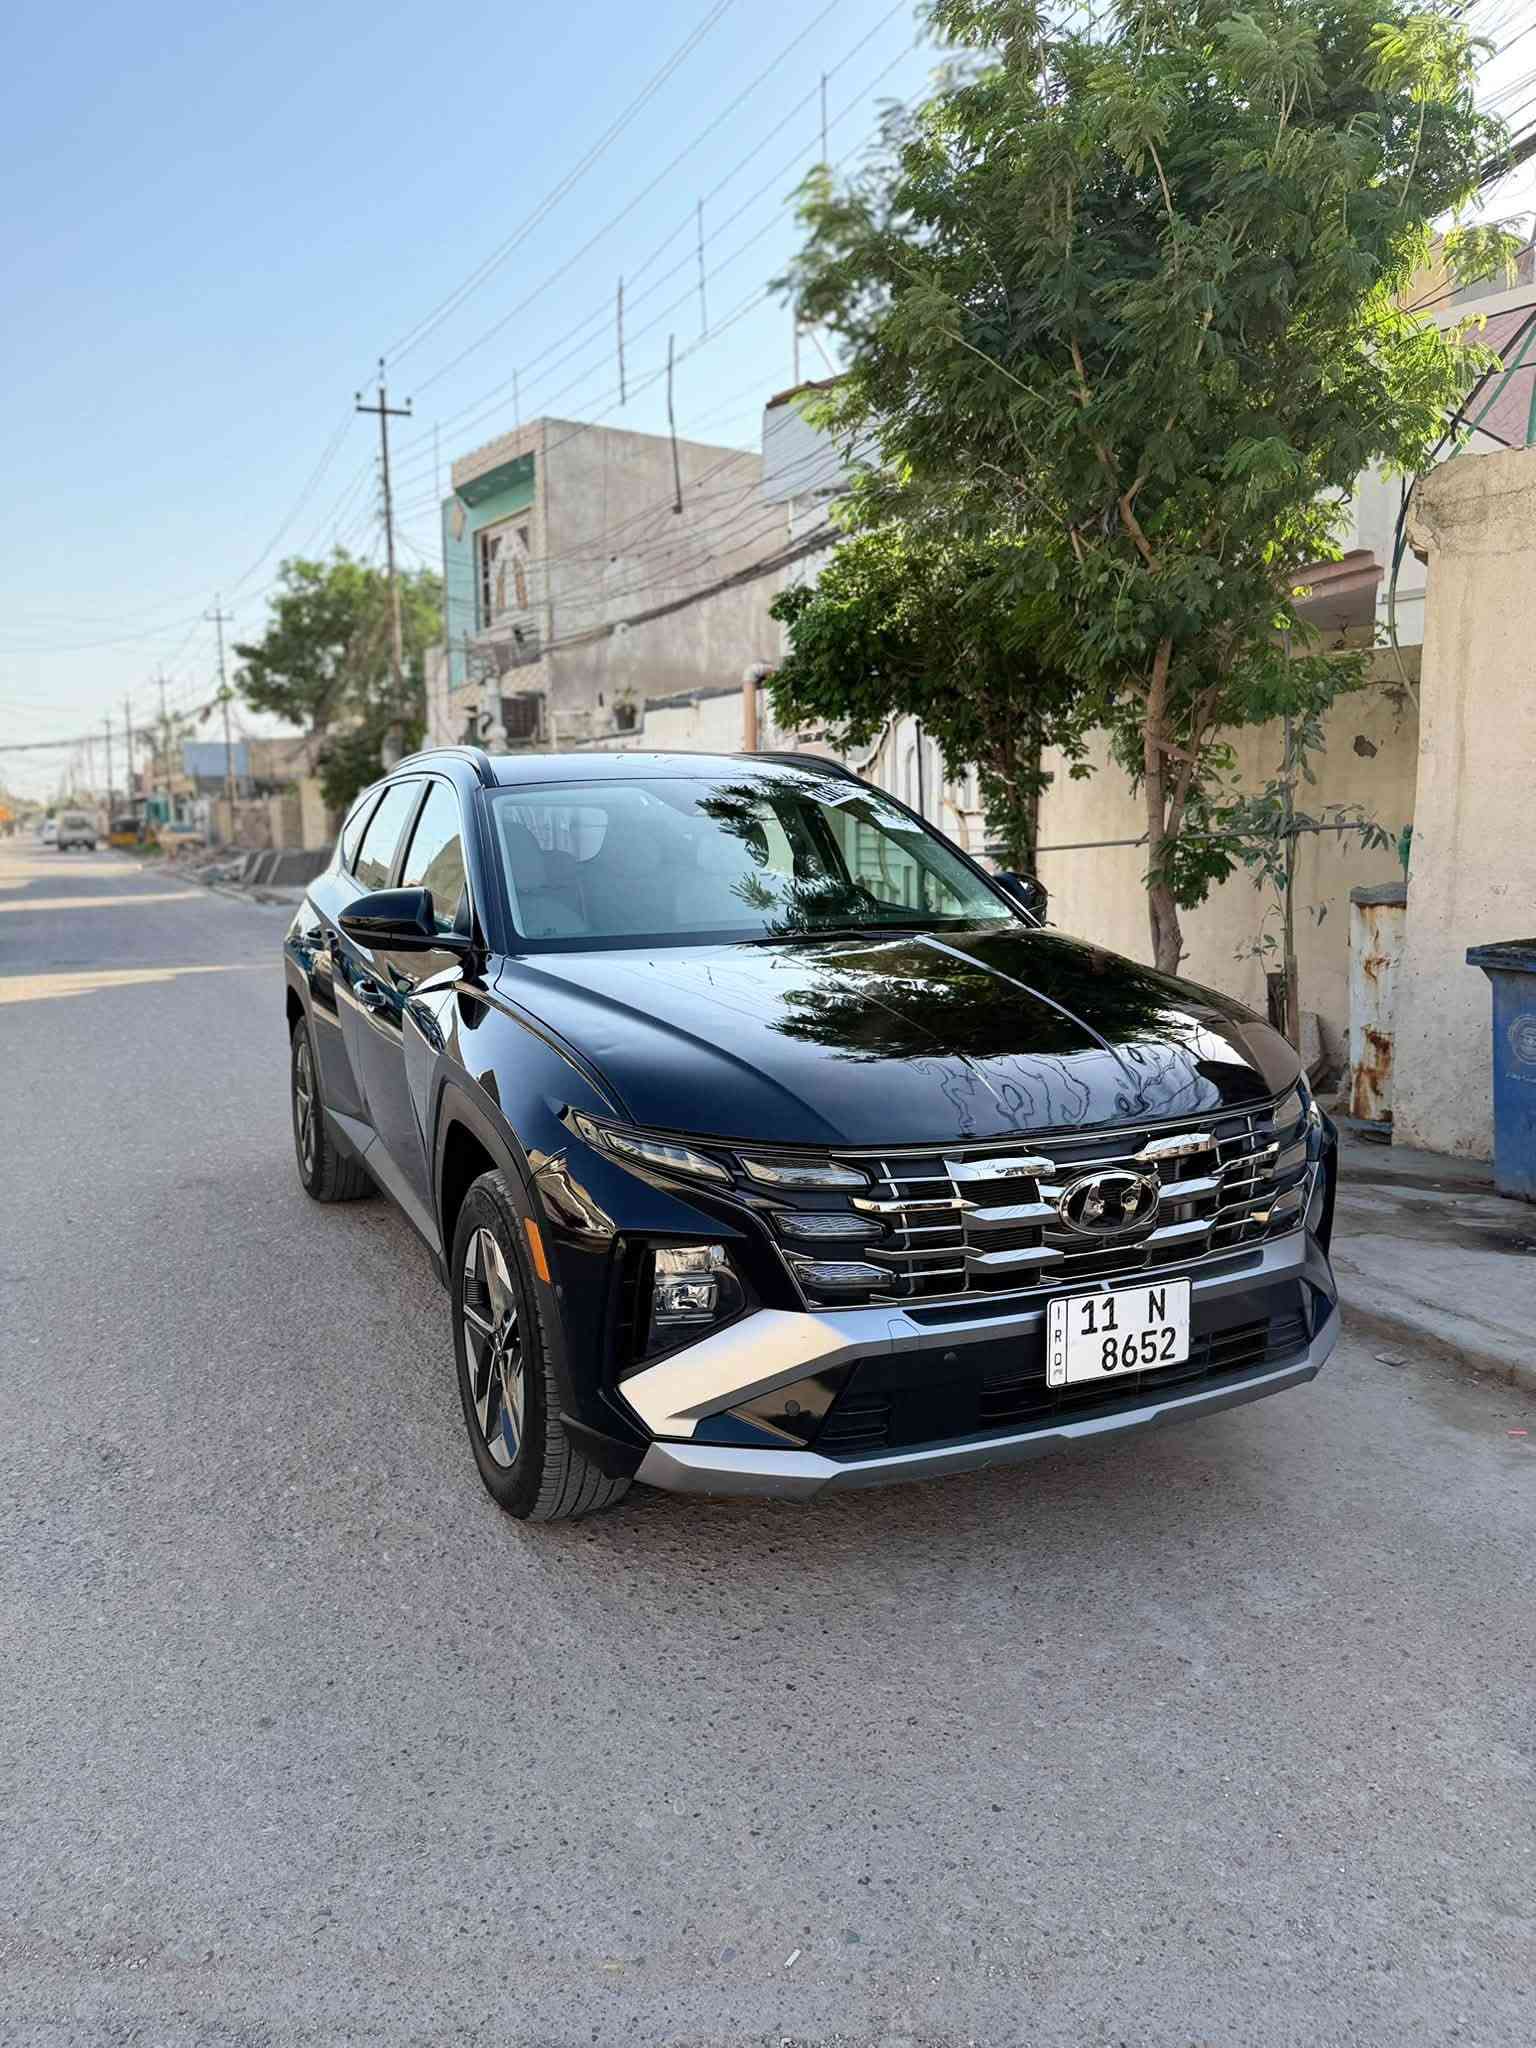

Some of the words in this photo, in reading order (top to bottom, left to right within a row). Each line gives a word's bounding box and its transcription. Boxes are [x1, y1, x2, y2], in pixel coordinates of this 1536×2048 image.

[1081, 1297, 1118, 1335] 11
[1148, 1288, 1166, 1323] N
[1101, 1326, 1177, 1371] 8652
